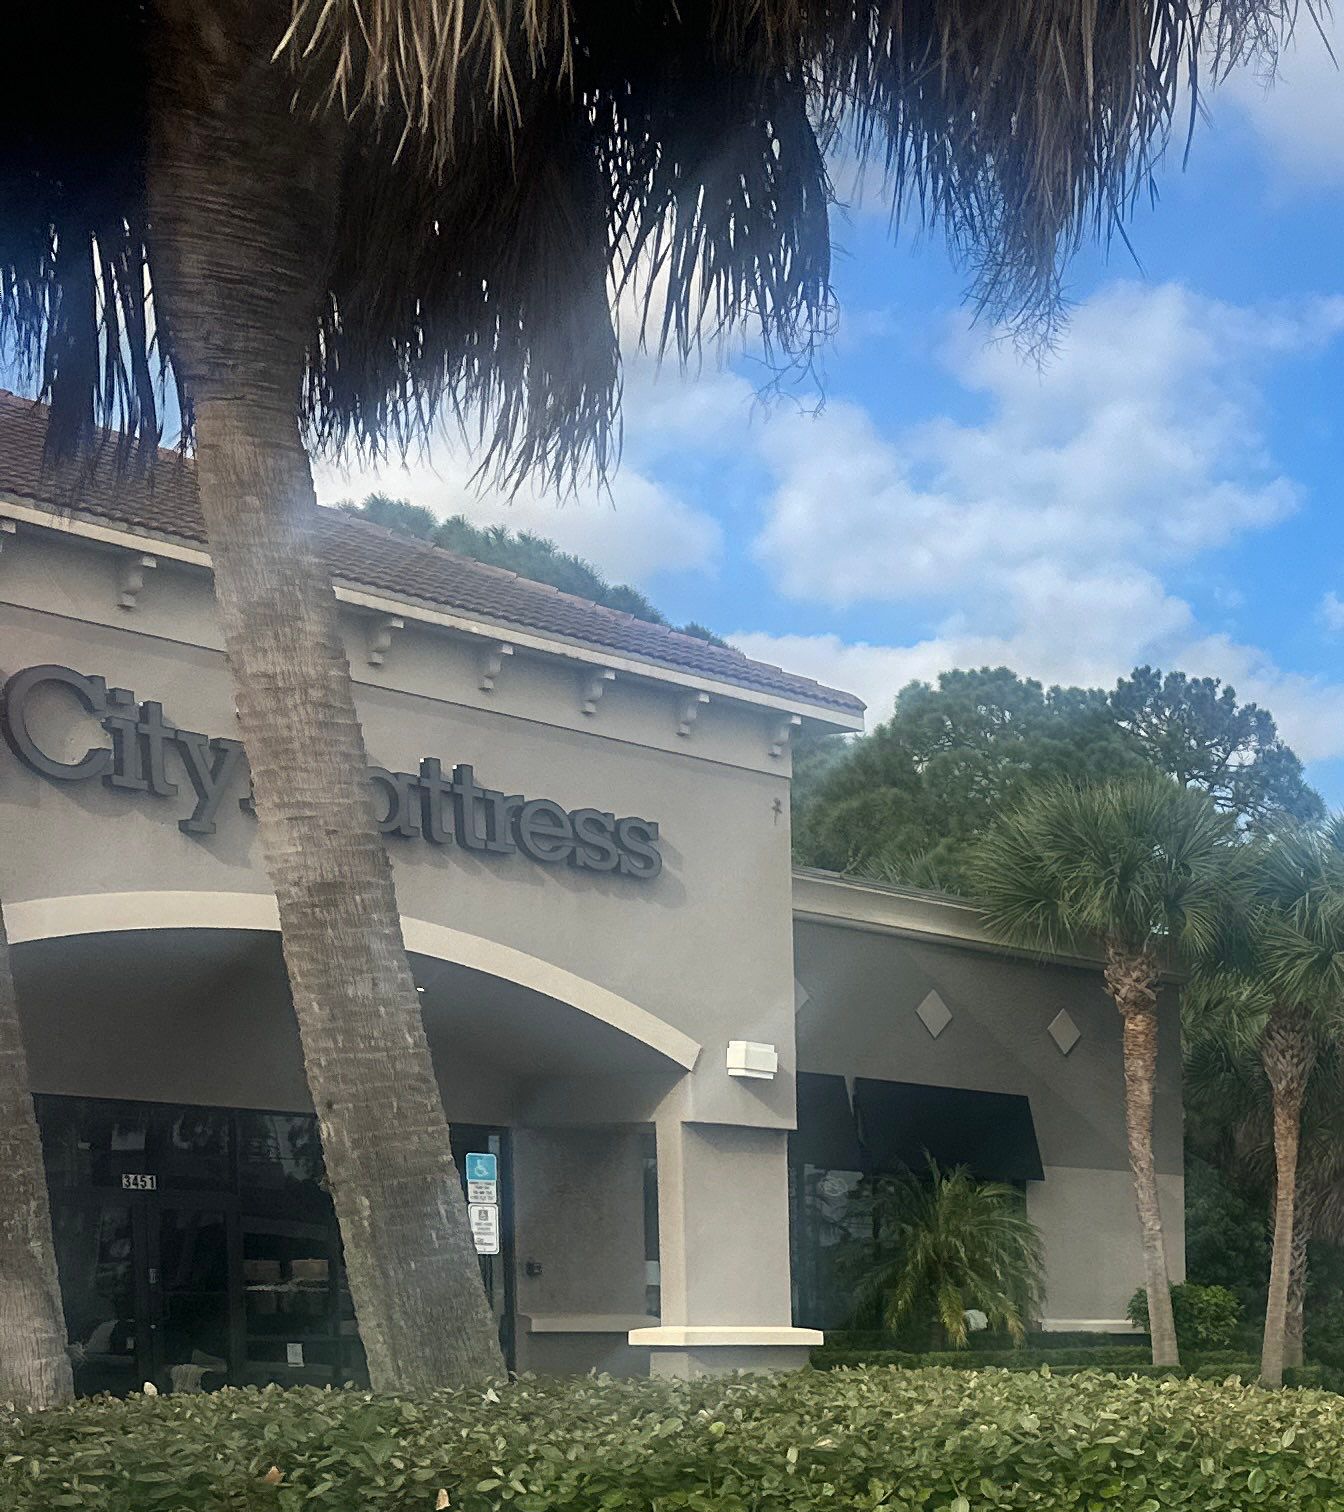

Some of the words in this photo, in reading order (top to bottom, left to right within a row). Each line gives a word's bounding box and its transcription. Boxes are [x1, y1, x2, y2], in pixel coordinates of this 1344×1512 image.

[2, 664, 246, 835] City
[240, 757, 663, 879] attress
[122, 1174, 156, 1189] 3451
